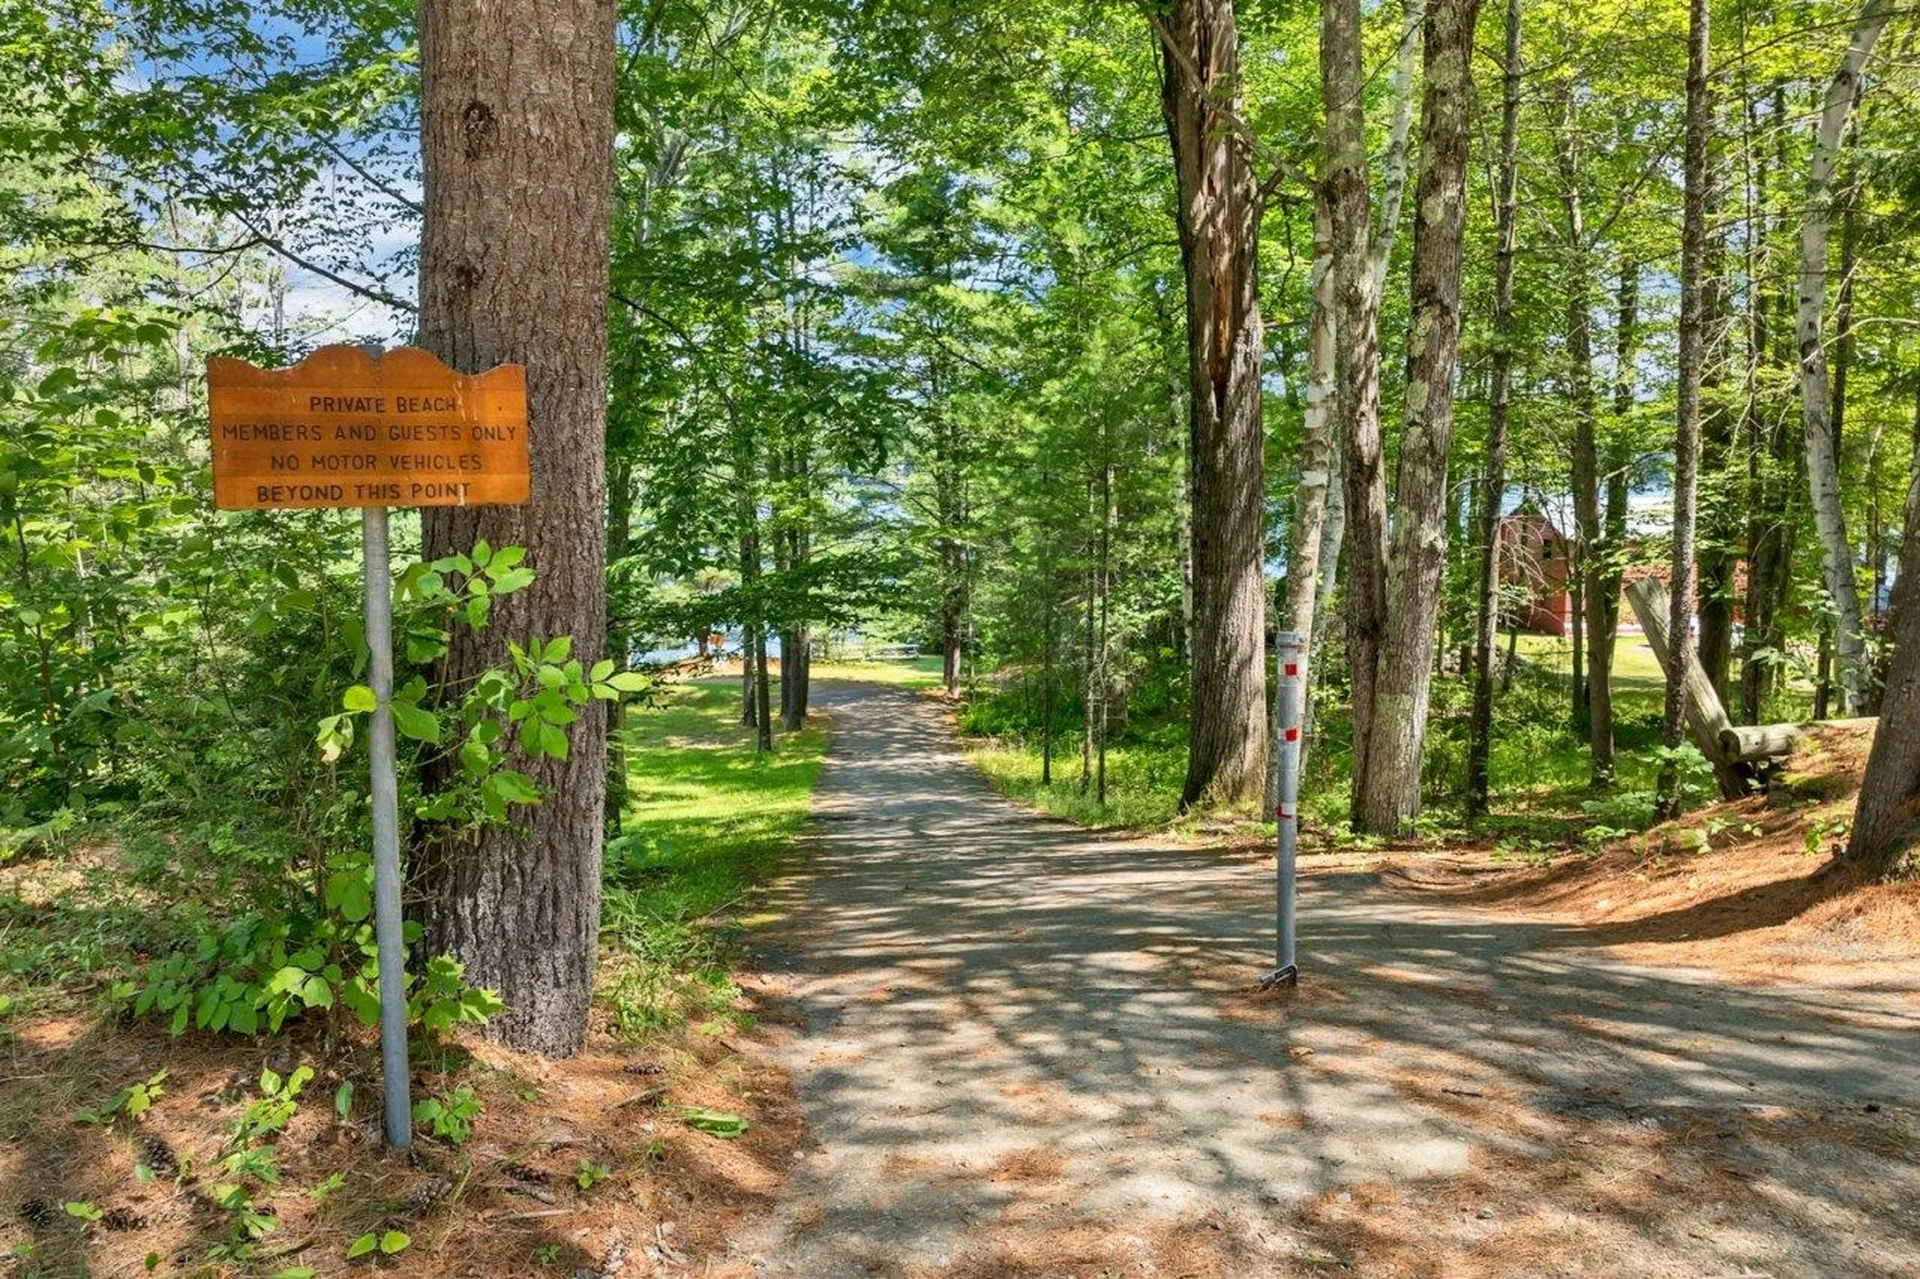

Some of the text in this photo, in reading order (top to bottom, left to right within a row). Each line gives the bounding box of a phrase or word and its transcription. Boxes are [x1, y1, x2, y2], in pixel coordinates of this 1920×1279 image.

[310, 396, 456, 413] PRIVATE BEACH
[222, 424, 516, 441] MEMBERS AND GUESTS ONLY
[271, 454, 482, 471] NO MOTOR VEHICLES
[257, 482, 470, 503] BEYOND THIS POINT
